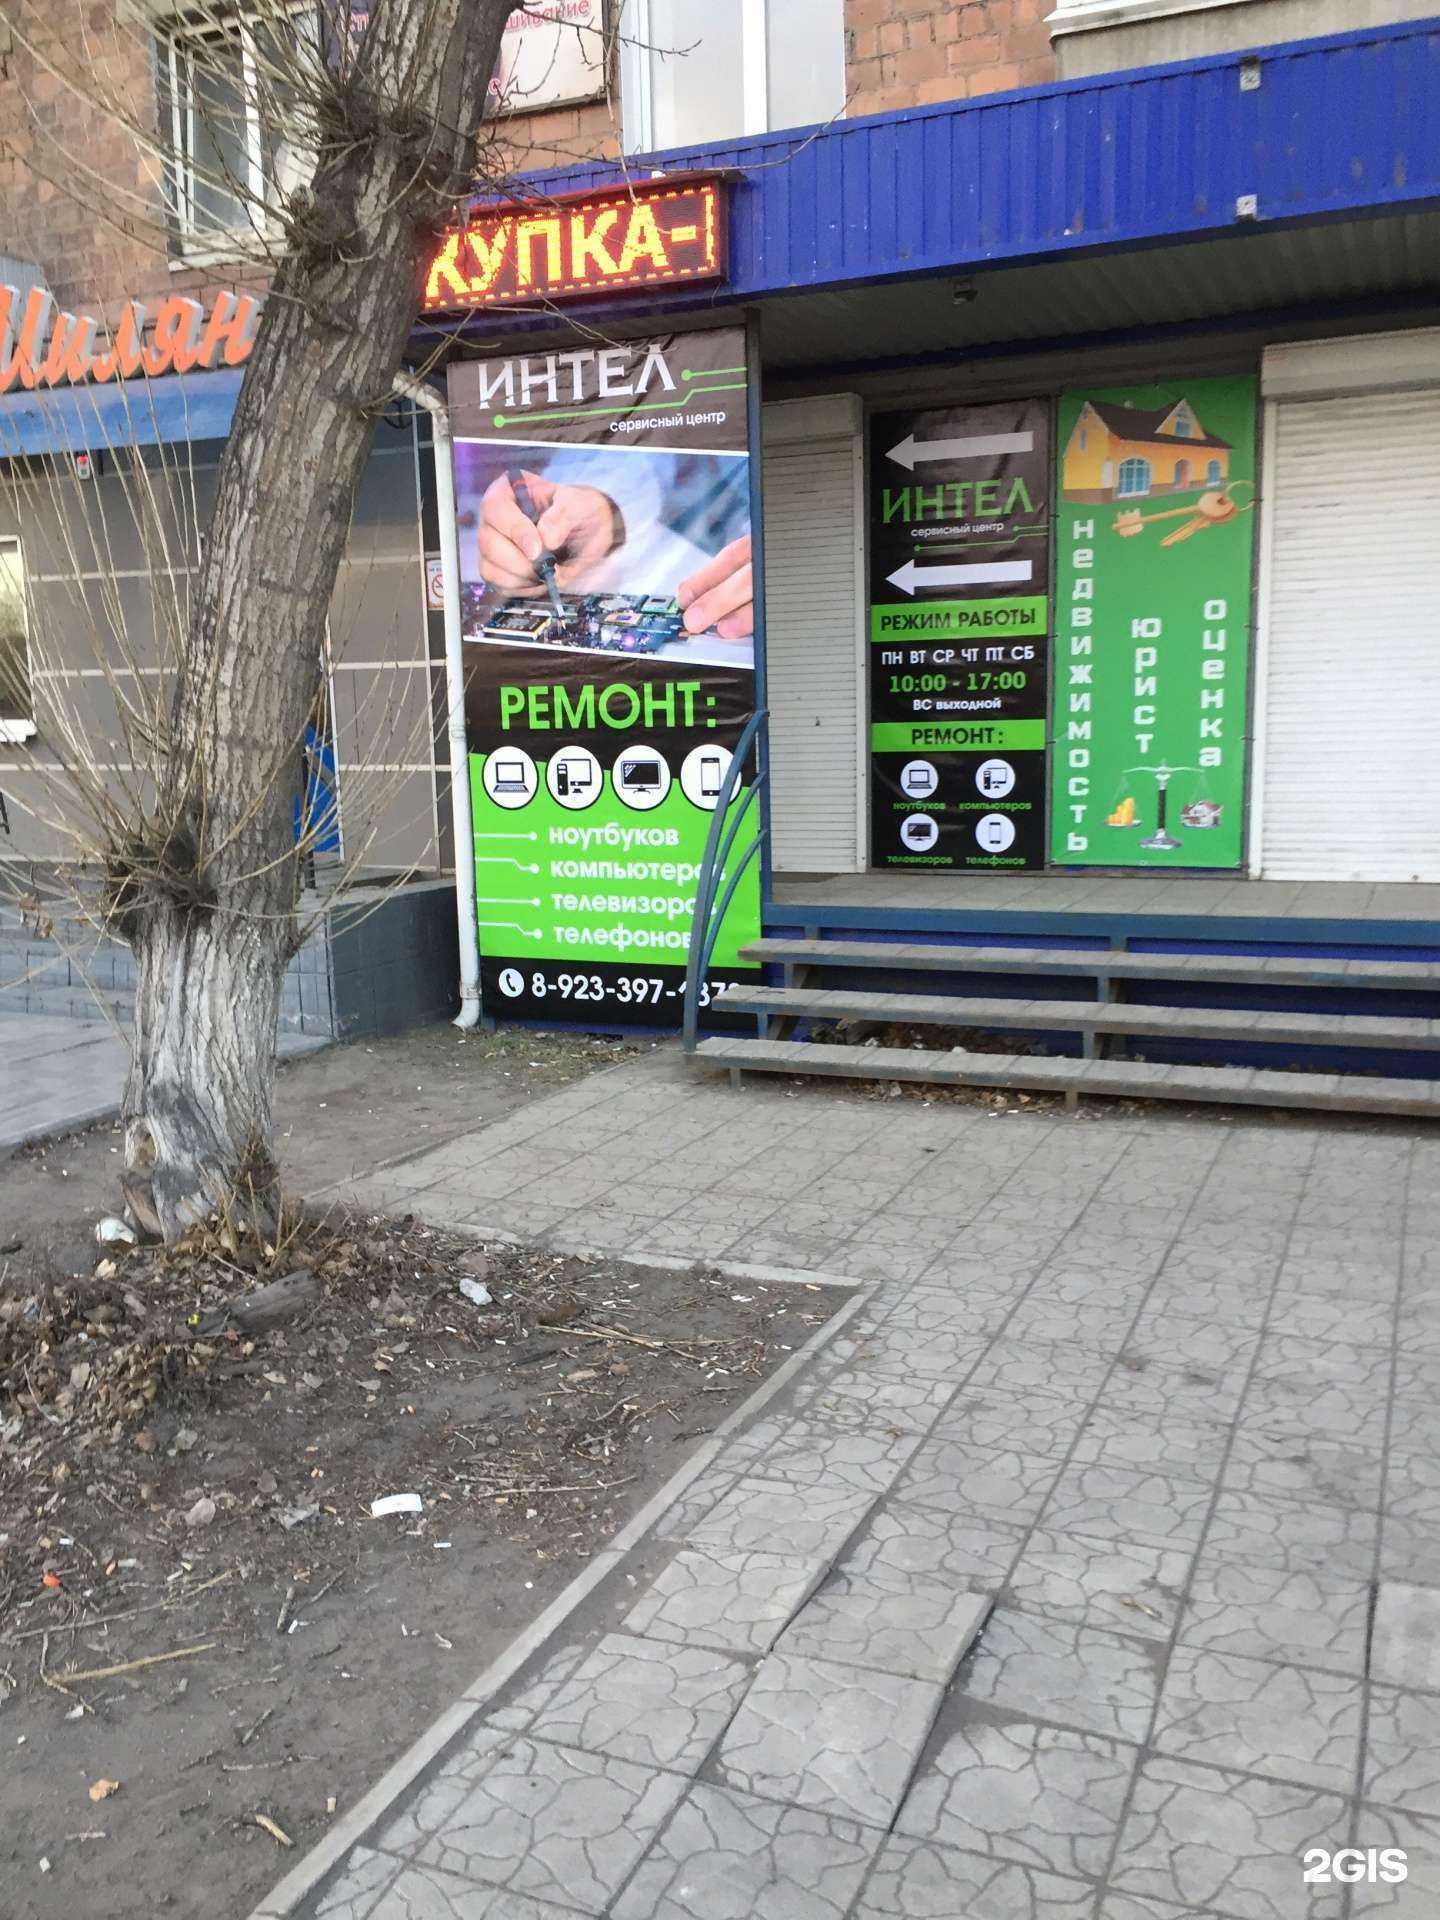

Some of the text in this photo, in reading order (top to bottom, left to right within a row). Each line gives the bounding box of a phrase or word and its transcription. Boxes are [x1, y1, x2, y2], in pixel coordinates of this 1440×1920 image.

[478, 344, 677, 410] ИНТЕЛ
[609, 411, 726, 433] сервисный центр
[881, 477, 1035, 524] ИНТЕЛ
[911, 522, 1005, 538] сервисный центр
[881, 608, 1036, 631] РЕЖИМ РАБОТЫ
[881, 645, 1035, 665] ПН ВТ СР ЧТ ПТ СБ
[889, 674, 947, 693] 10:00
[966, 671, 1027, 690] 17:00
[1066, 519, 1095, 852] недвижимость
[1198, 599, 1228, 767] оценка
[500, 681, 716, 730] РЕМОНТ:
[912, 697, 1002, 711] ВС выходной
[892, 801, 946, 811] ноутбуков
[959, 801, 1032, 811] компьютеров
[549, 822, 680, 851] ноутбуков
[887, 855, 953, 865] телевизоров
[966, 855, 1026, 866] телефонов
[551, 893, 717, 920] телевизоро
